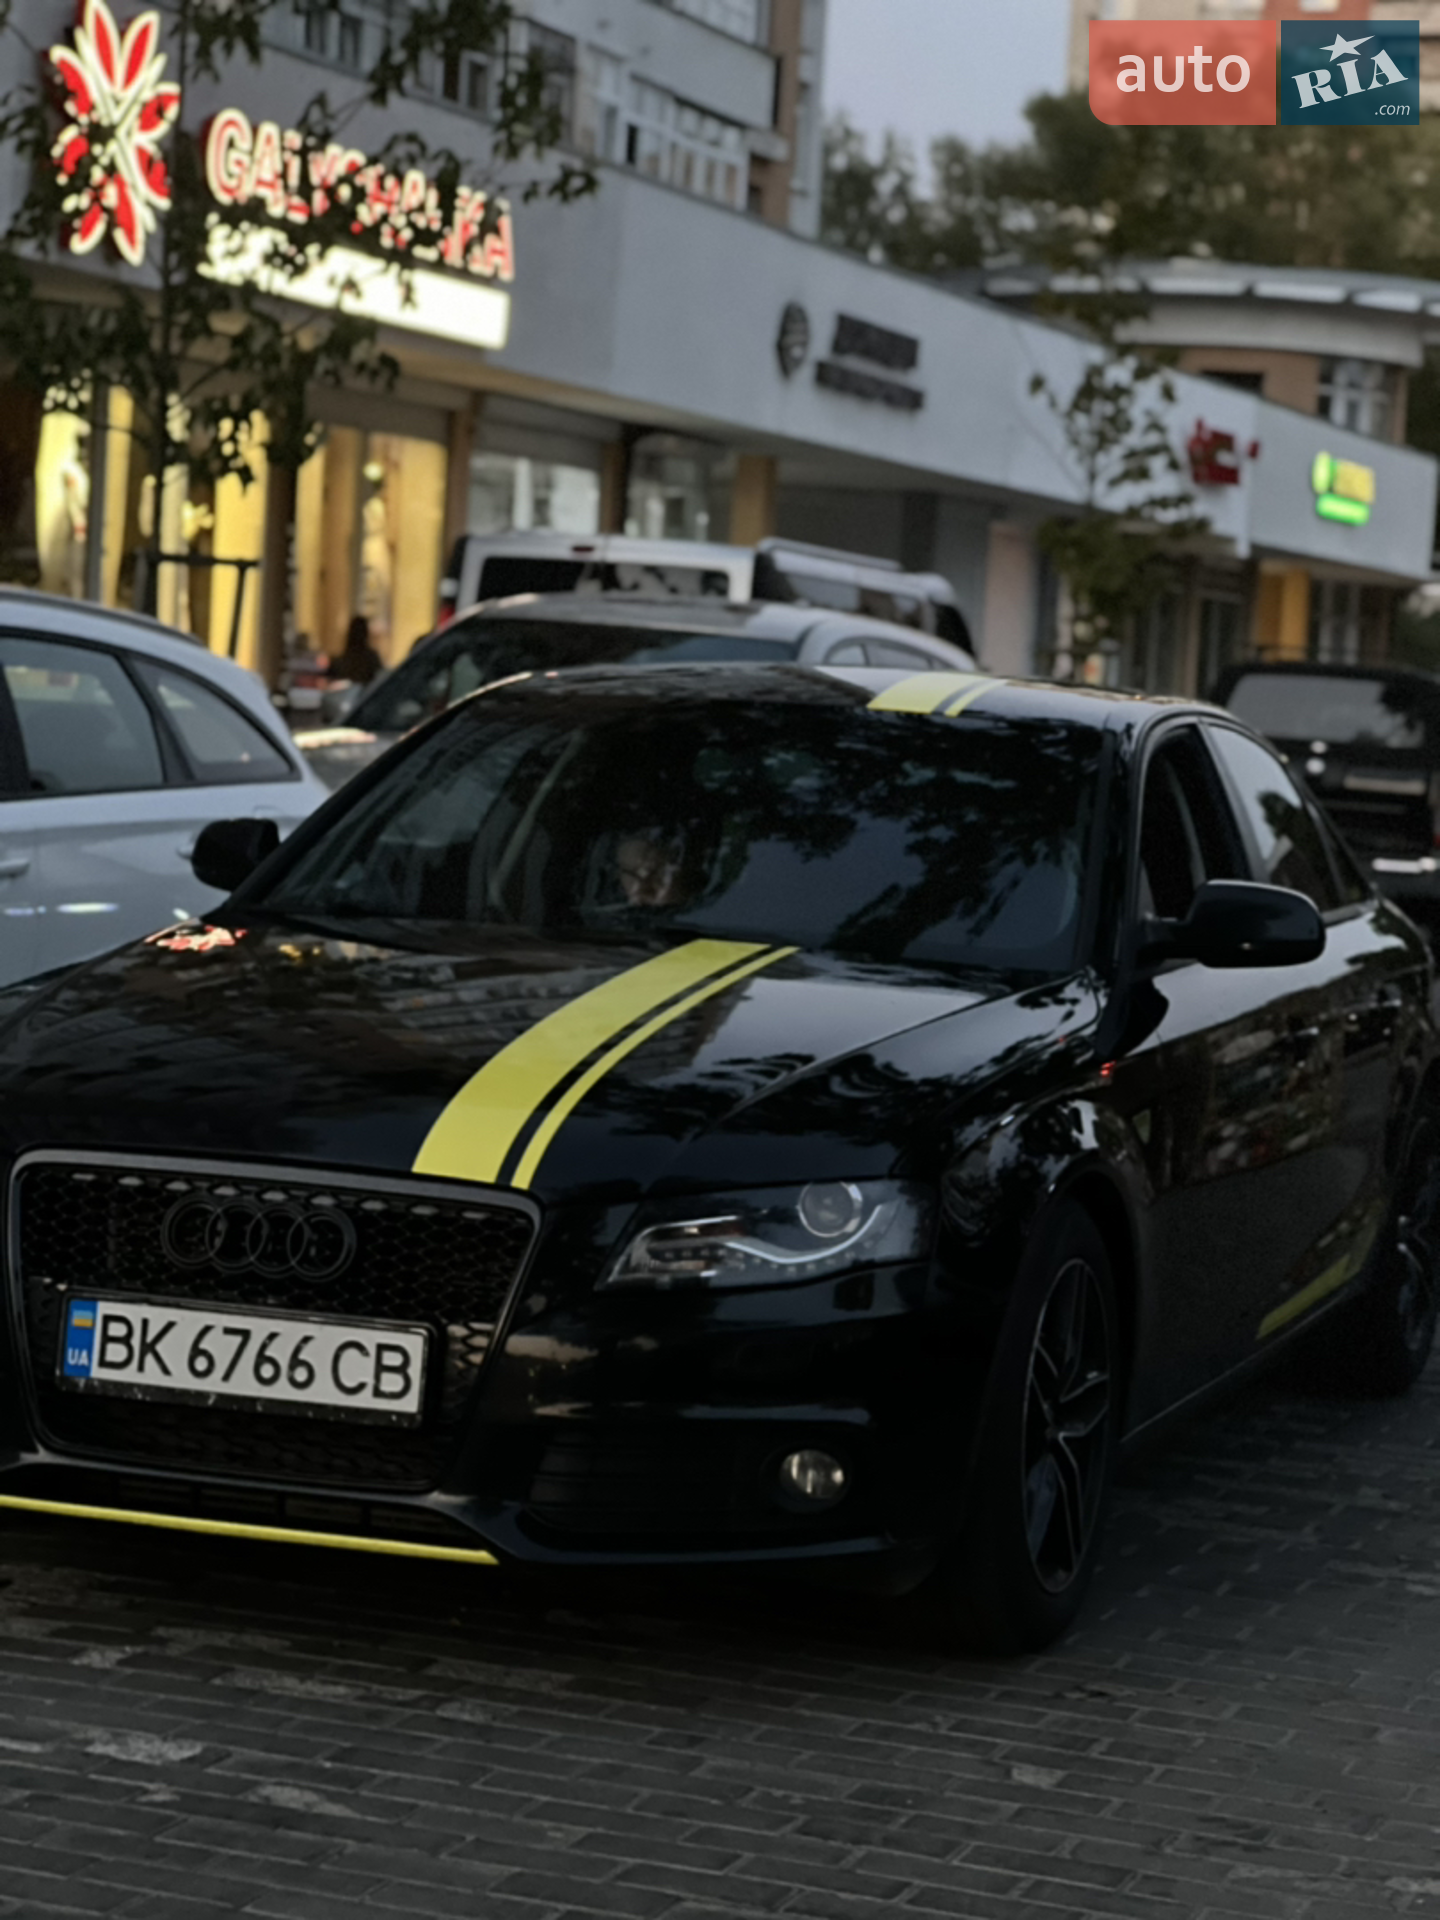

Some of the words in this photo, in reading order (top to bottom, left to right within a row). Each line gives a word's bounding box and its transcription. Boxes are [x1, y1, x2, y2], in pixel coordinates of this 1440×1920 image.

[205, 107, 515, 283] GALYCHAKA
[67, 1347, 90, 1367] UA
[98, 1314, 178, 1376] BK
[187, 1324, 316, 1390] 6766
[331, 1340, 412, 1400] CB
